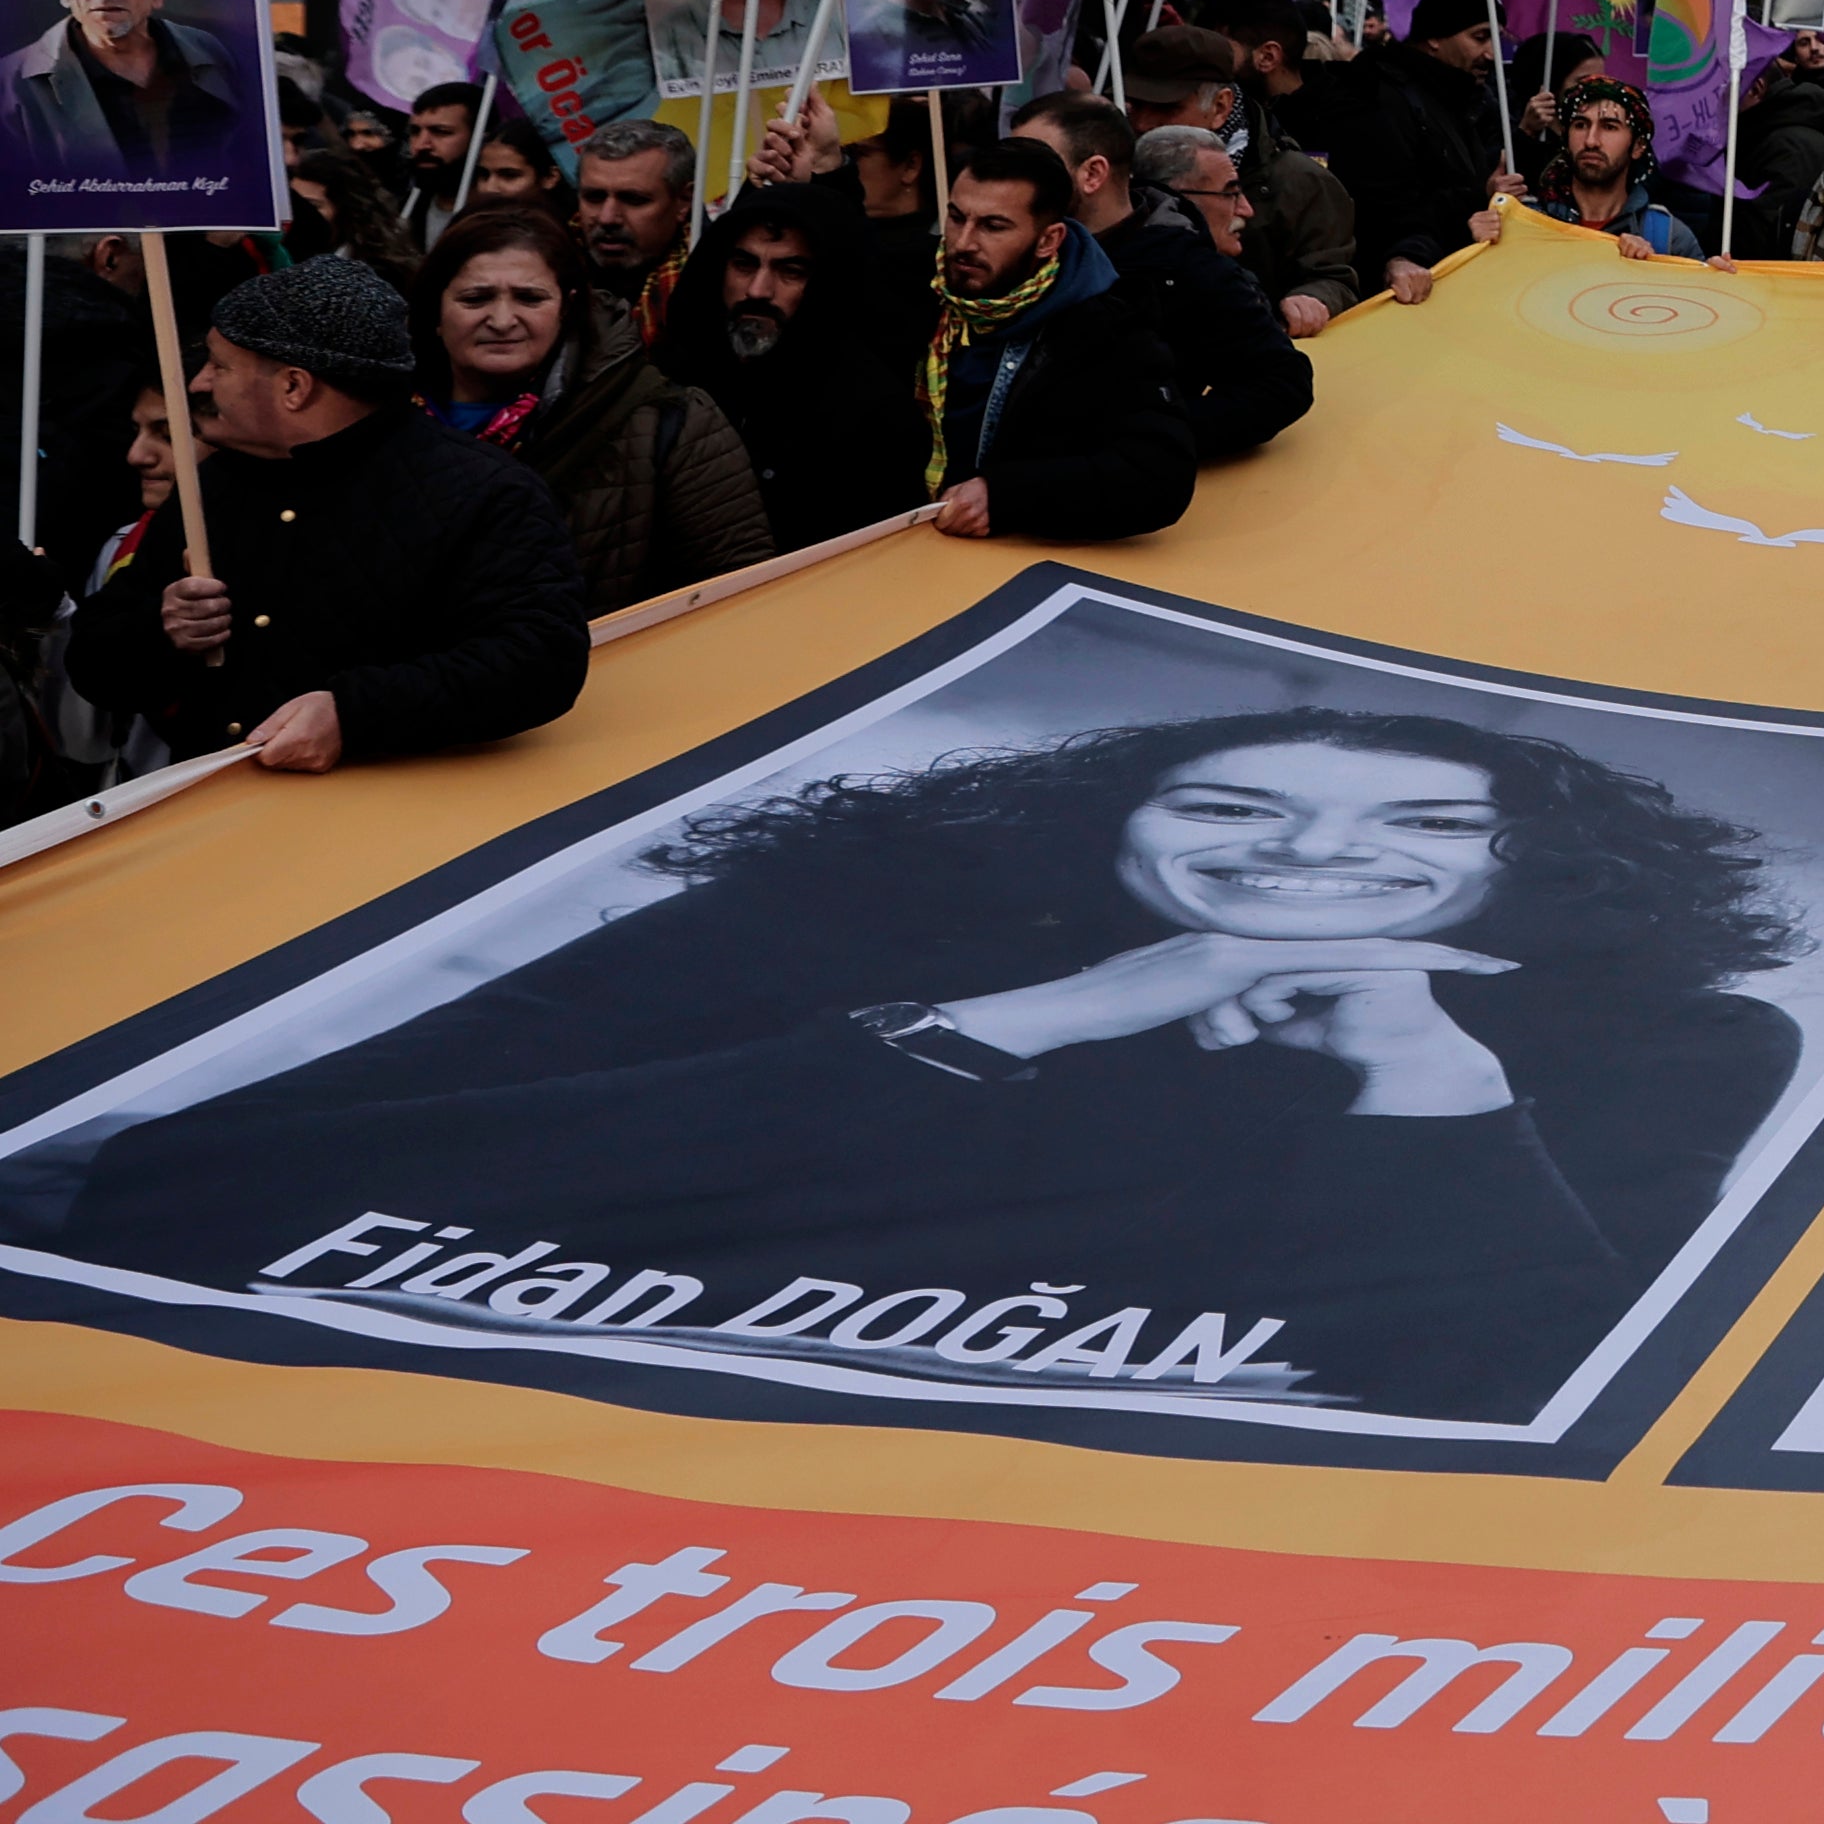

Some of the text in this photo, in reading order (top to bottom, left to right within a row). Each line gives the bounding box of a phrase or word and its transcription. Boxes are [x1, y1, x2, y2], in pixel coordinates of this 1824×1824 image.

[256, 1209, 1288, 1386] Fidan DOĞAN
[0, 1480, 534, 1638] Ces
[534, 1544, 1244, 1715] trois
